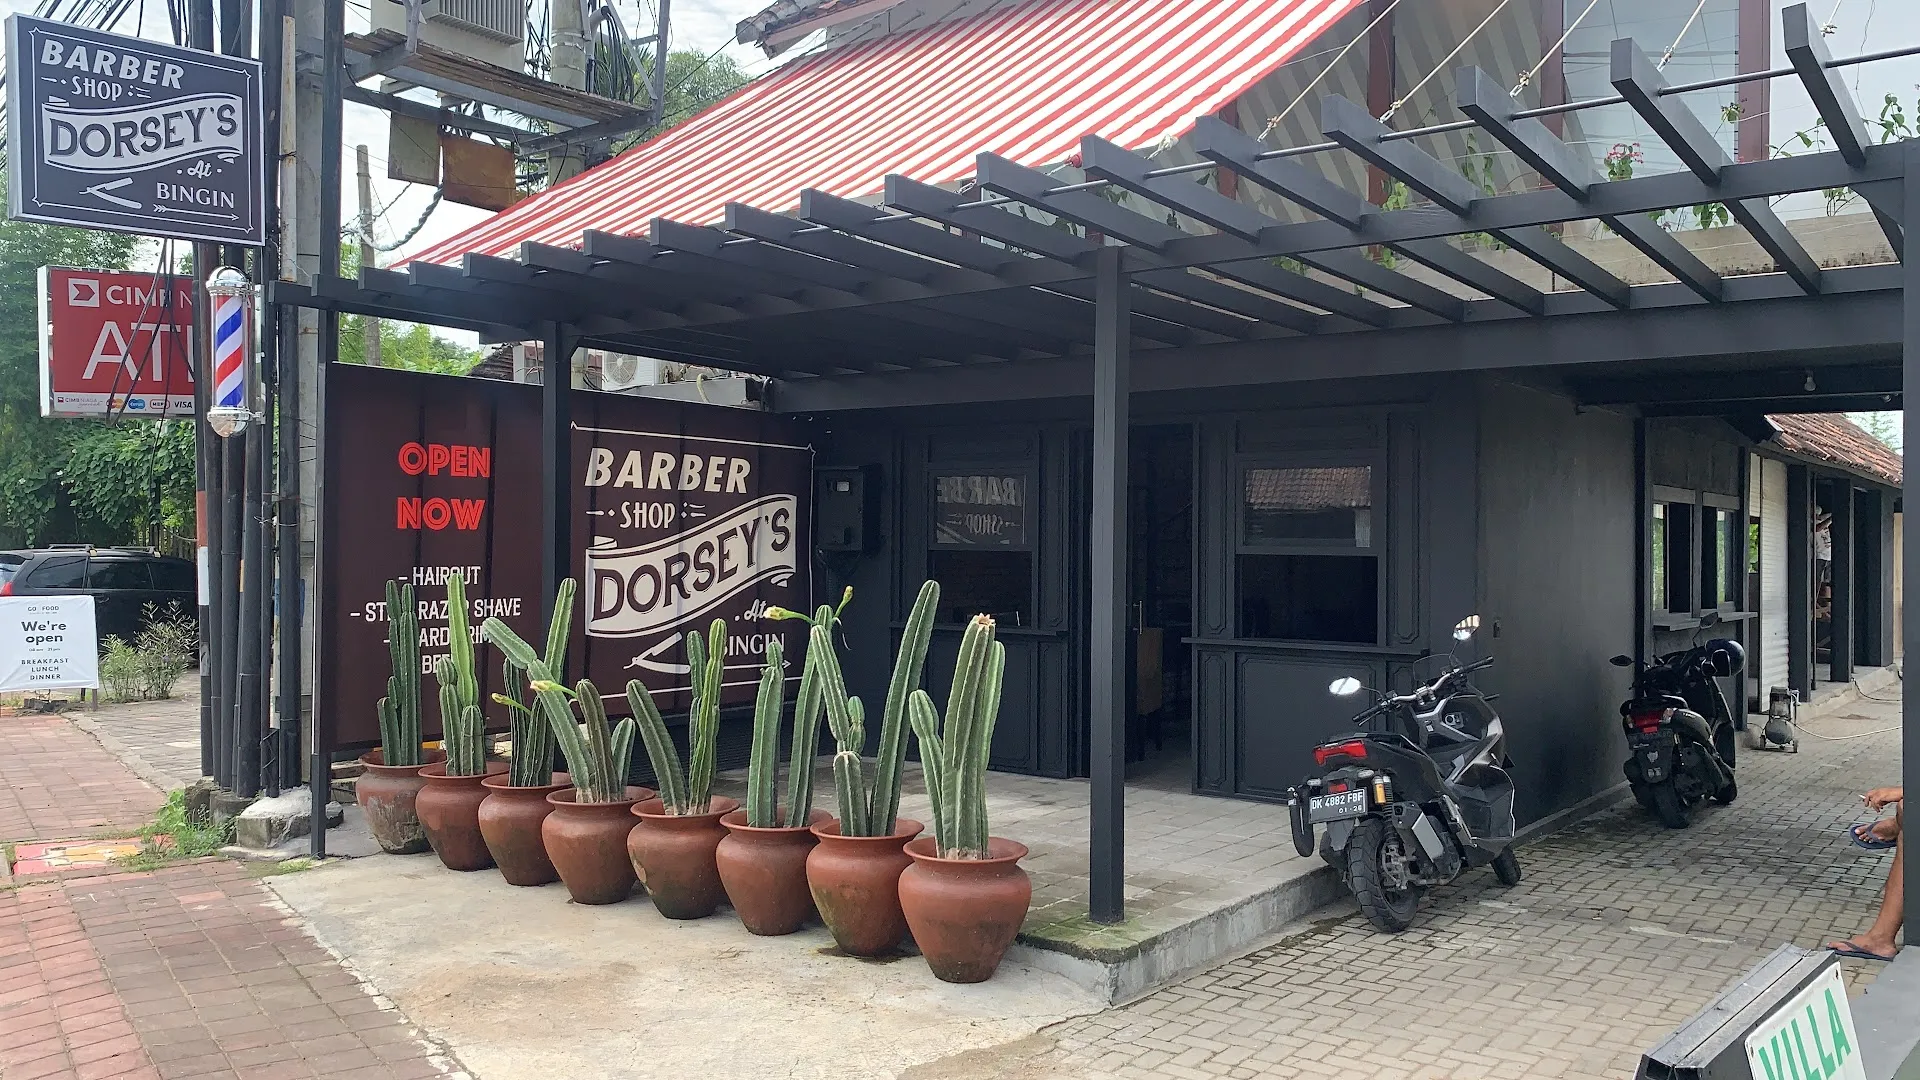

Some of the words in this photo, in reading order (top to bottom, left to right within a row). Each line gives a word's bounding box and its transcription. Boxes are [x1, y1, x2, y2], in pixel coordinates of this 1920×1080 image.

[41, 39, 185, 90] BARBER
[71, 75, 123, 101] SHOP
[49, 104, 238, 158] DORSEY'S
[187, 160, 212, 178] At
[156, 182, 235, 209] BINGIN
[82, 320, 195, 383] AT
[398, 442, 491, 478] OPEN
[584, 447, 751, 494] BARBER
[397, 497, 485, 530] NOW
[620, 501, 676, 529] SHOP
[591, 507, 790, 622] DORSEY'S
[418, 599, 469, 621] RAZ
[474, 597, 522, 618] SHAVE
[21, 620, 67, 632] We're
[418, 627, 450, 647] ARD
[25, 635, 63, 646] open
[724, 633, 785, 656] INGIN
[21, 657, 69, 665] BREAKFAST
[30, 673, 61, 681] DINNER
[1312, 799, 1323, 809] DK
[1325, 795, 1345, 807] 4882
[1347, 792, 1363, 803] FBF
[1758, 987, 1852, 1080] VILLA
